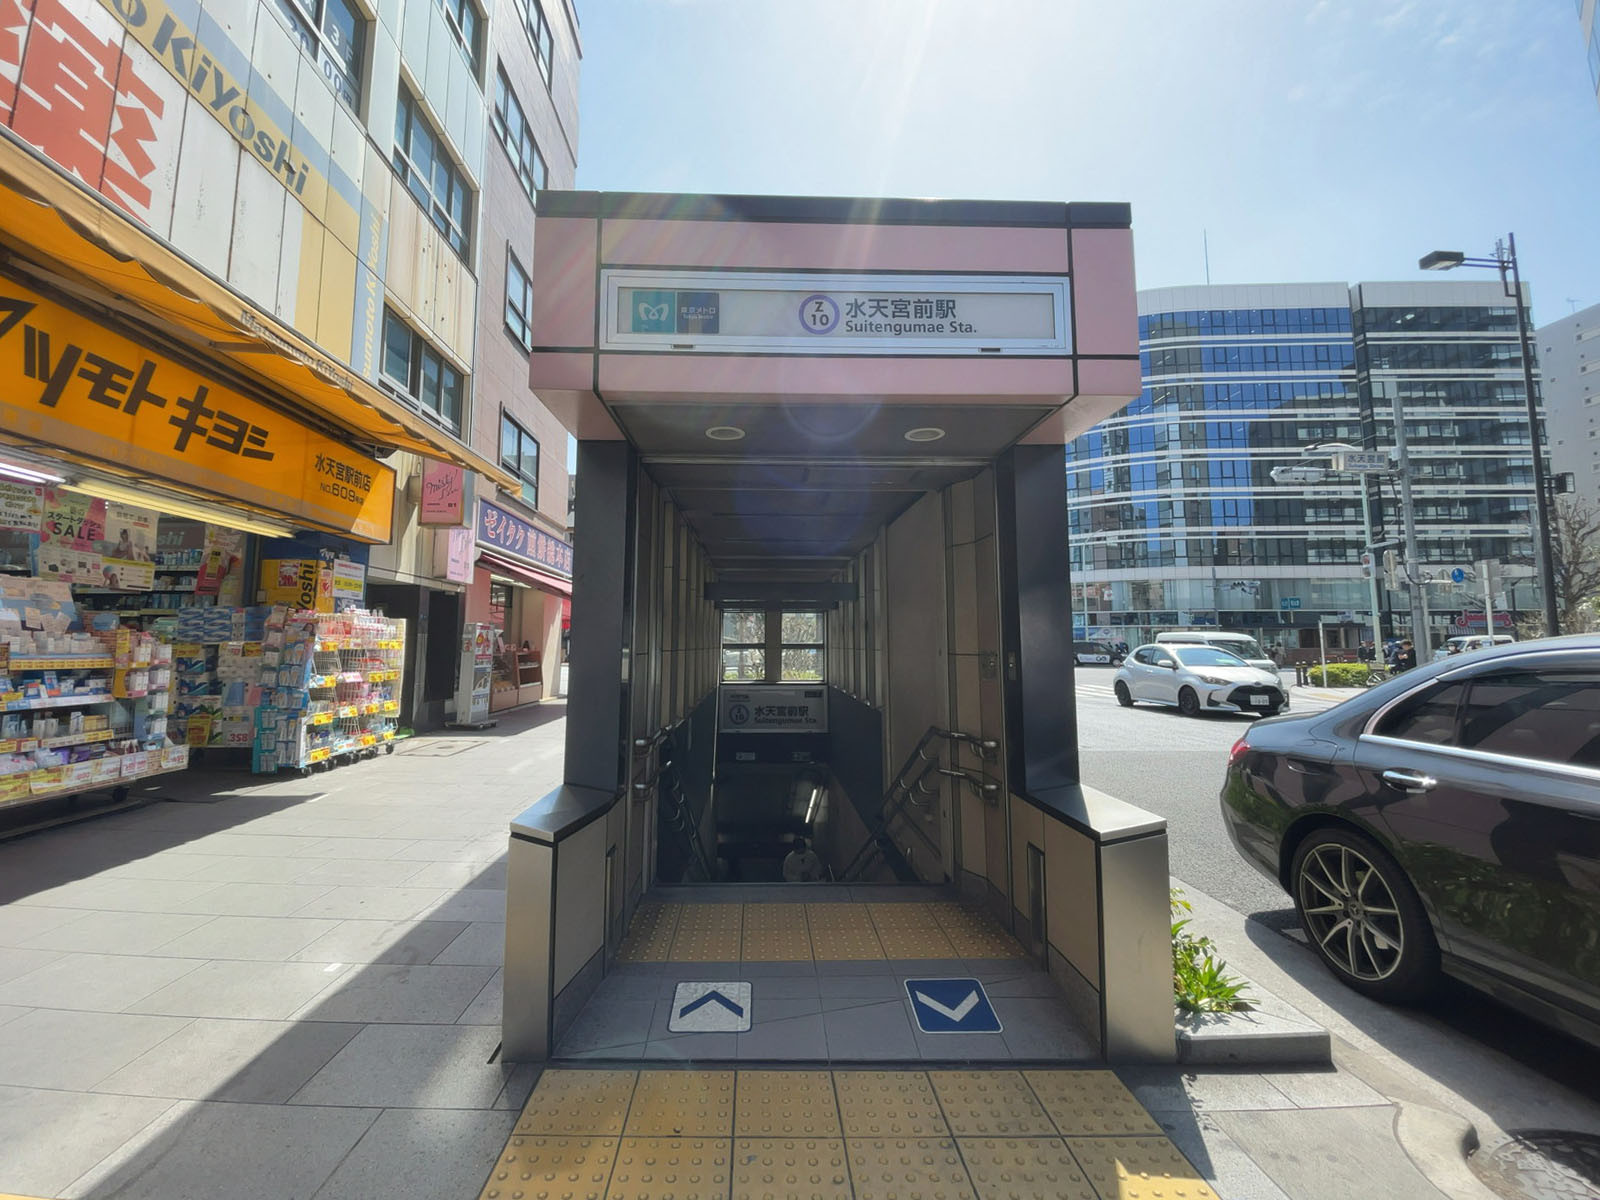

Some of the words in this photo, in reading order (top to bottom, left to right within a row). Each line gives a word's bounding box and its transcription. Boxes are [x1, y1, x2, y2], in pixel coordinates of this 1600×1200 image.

[814, 301, 824, 313] Z
[845, 299, 957, 319] 水天宮前駅
[811, 314, 830, 326] 10
[845, 320, 945, 336] Suitengumae
[949, 321, 977, 334] Sta.
[314, 452, 372, 493] 水天宮駅前店
[53, 522, 96, 541] SALE
